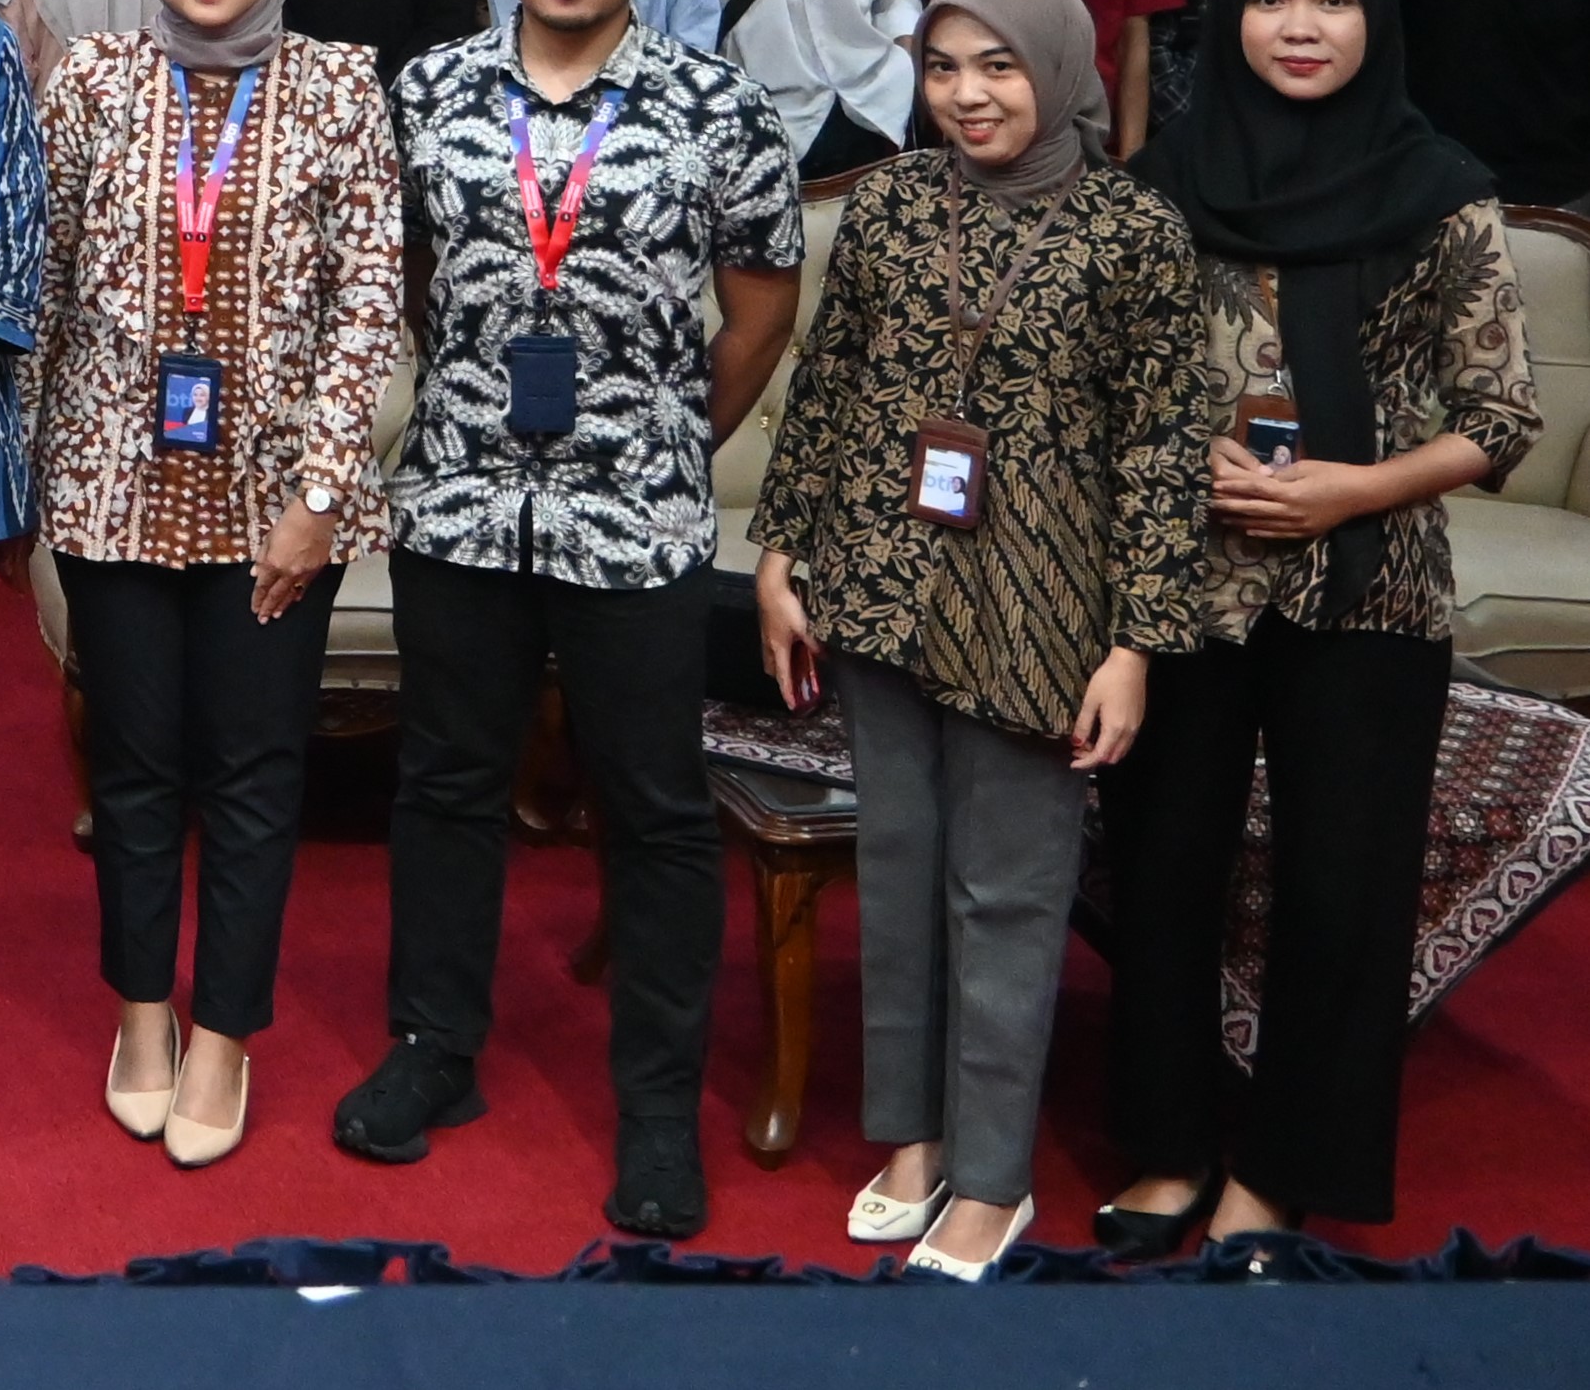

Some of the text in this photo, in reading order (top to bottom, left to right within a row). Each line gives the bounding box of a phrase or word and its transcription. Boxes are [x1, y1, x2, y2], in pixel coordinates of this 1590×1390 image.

[510, 98, 523, 120] btn
[593, 101, 613, 123] btn
[221, 122, 239, 144] btn
